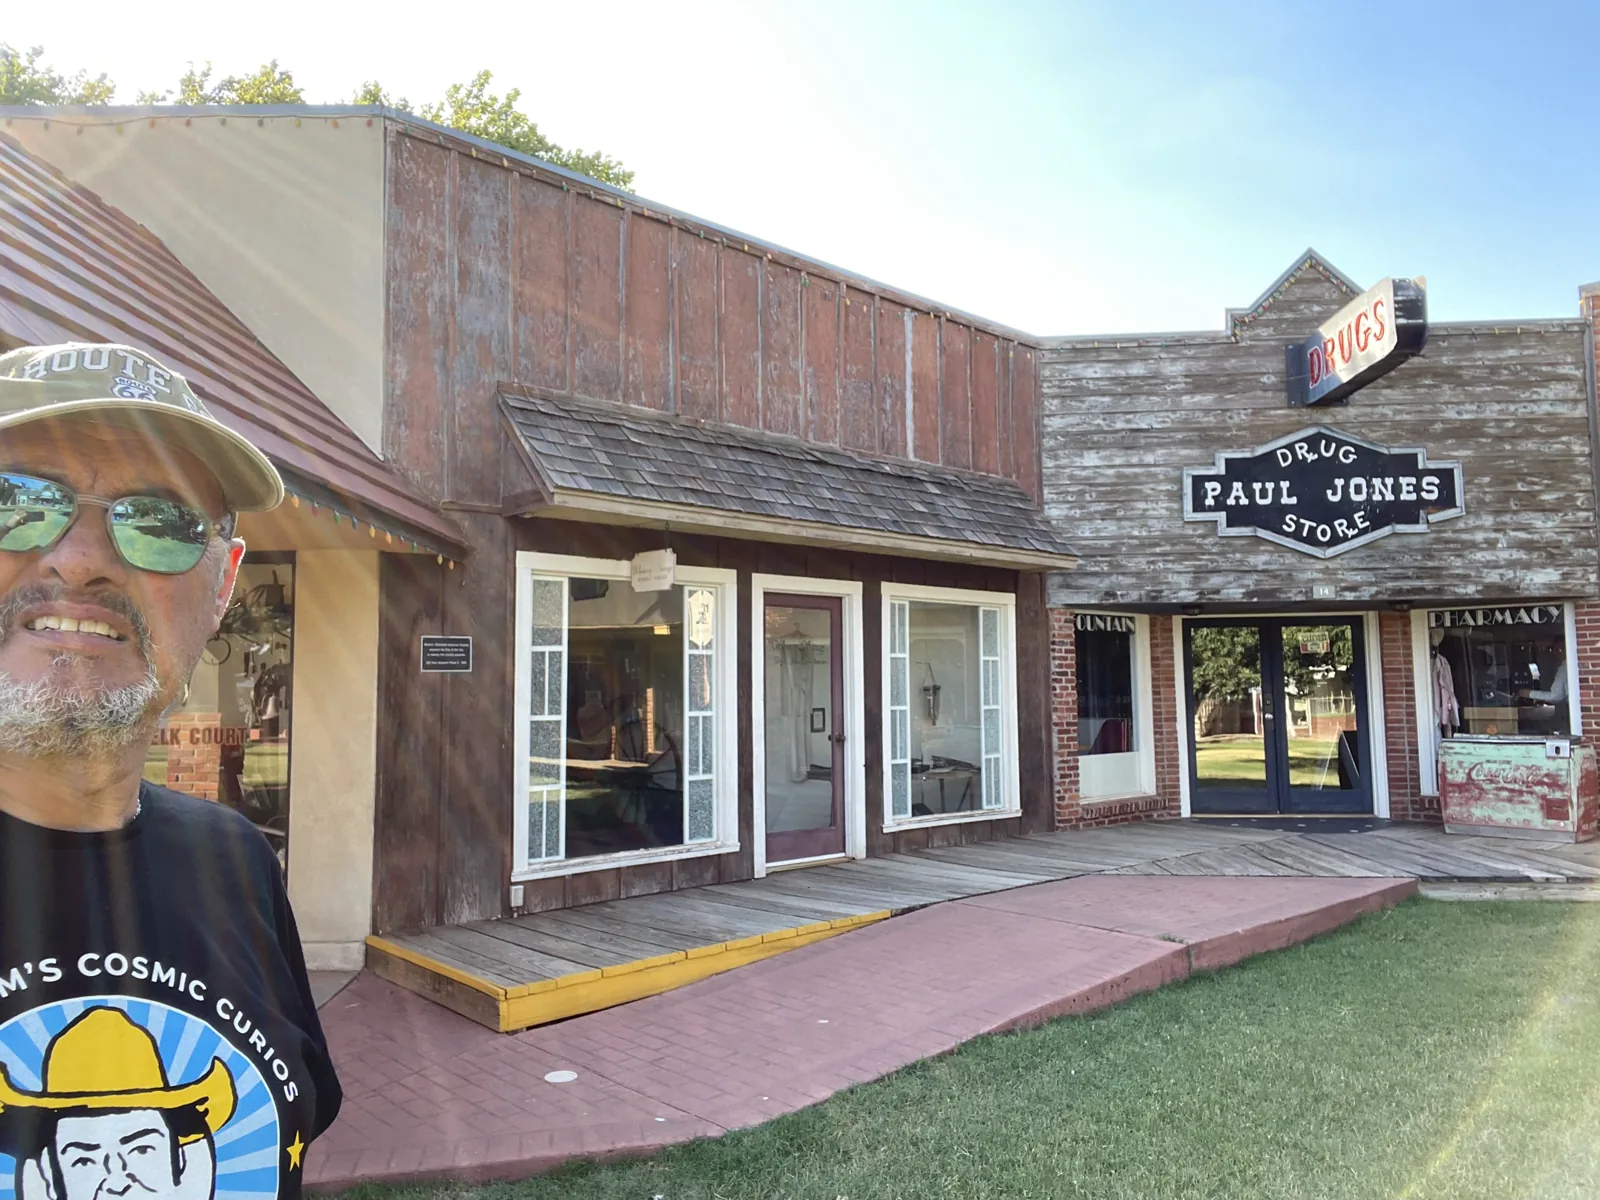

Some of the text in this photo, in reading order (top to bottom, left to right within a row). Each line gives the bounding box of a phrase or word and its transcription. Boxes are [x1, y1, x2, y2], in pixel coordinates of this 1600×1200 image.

[1308, 299, 1385, 389] DRUGS
[23, 348, 172, 393] ROUTE
[1277, 439, 1358, 468] DRUG
[1204, 476, 1441, 507] PAUL JONES
[1282, 510, 1371, 543] STORE
[1076, 615, 1135, 632] OUNTAIN
[1429, 606, 1563, 628] PHARMACY
[189, 727, 247, 746] COURT
[77, 952, 207, 1001] COSMIC
[215, 998, 299, 1103] CURIOS
